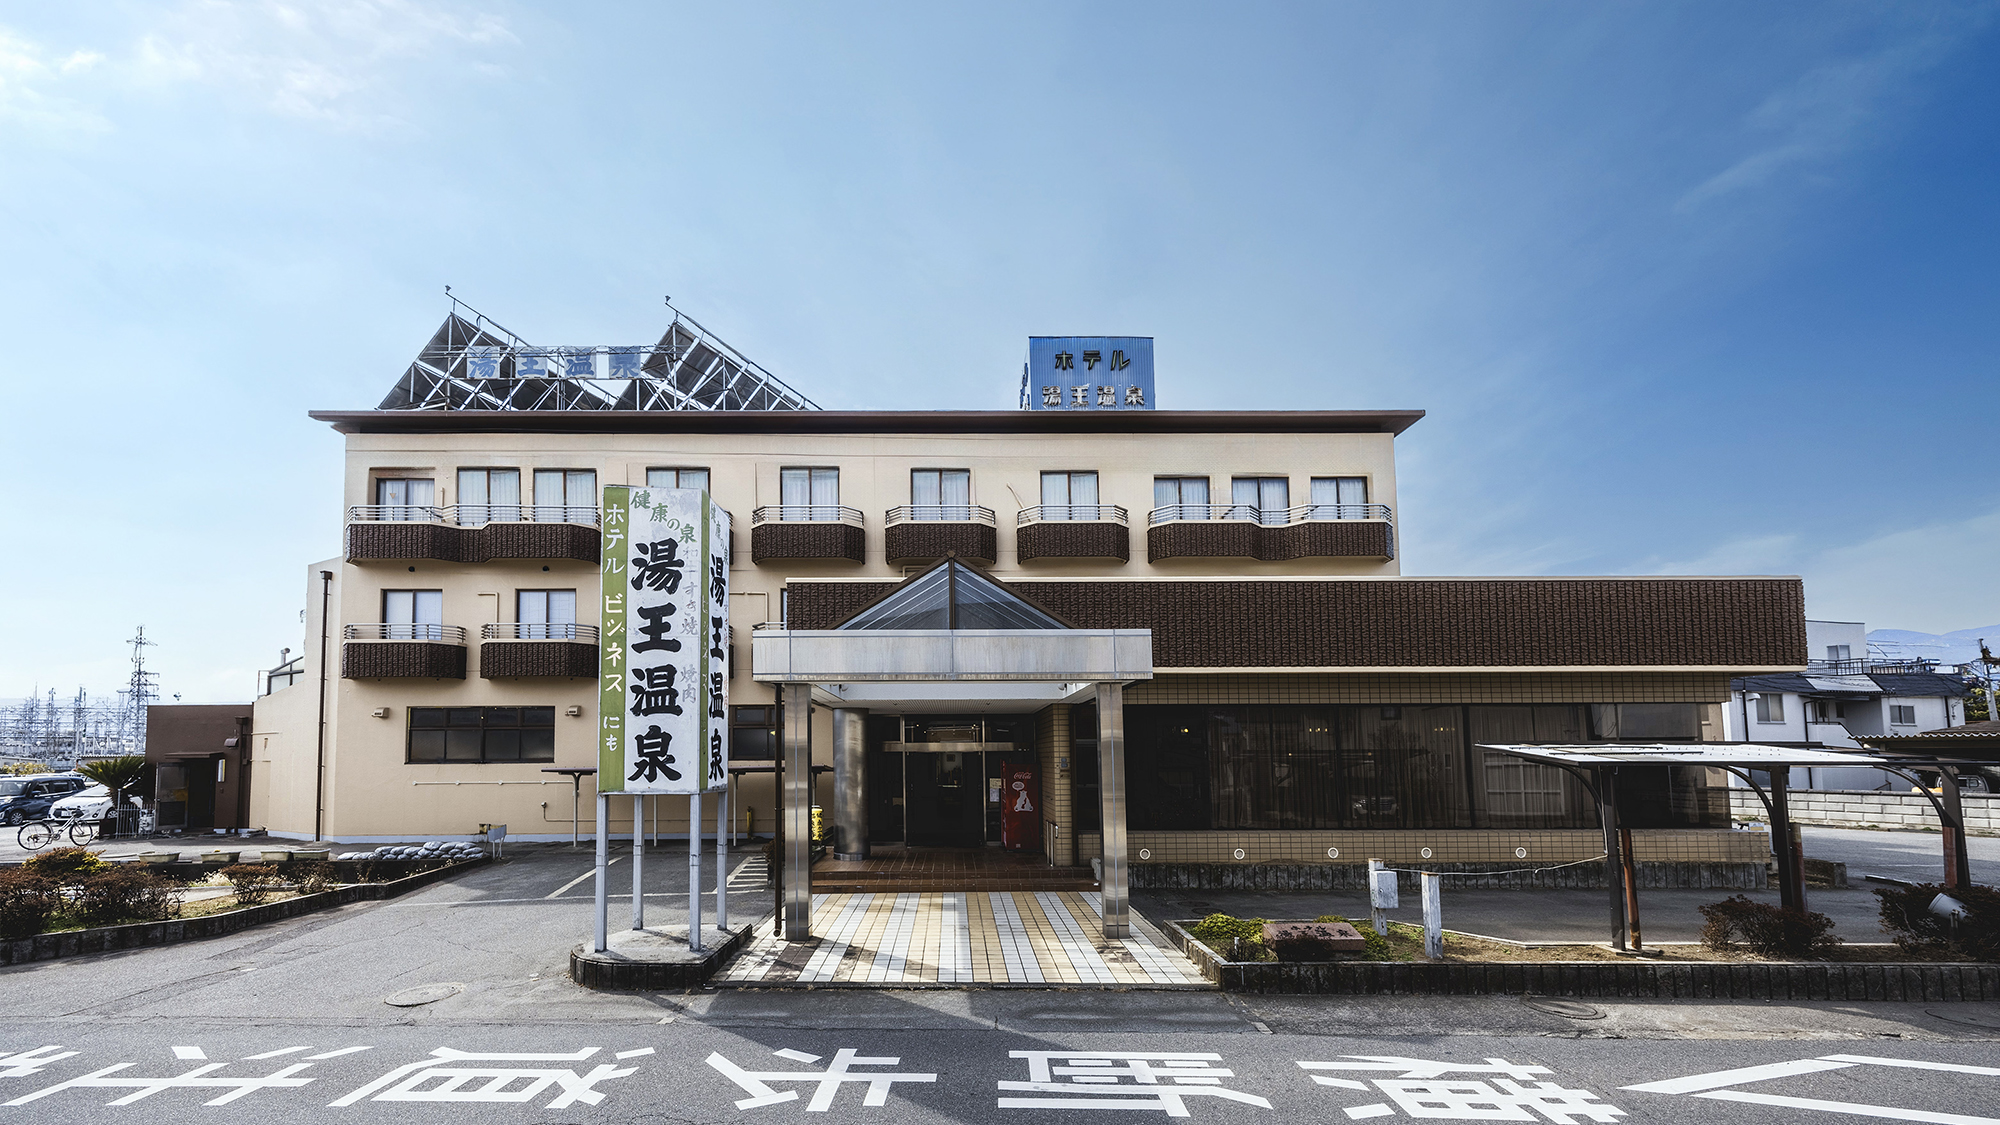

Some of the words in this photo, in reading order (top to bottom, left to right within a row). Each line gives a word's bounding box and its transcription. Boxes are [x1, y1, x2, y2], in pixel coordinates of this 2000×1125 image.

[468, 346, 638, 378] 湯王温泉
[1055, 350, 1130, 371] ホテル
[1042, 384, 1145, 407] 湯王温泉
[604, 503, 625, 574] ホテル
[630, 489, 697, 544] 健康の泉
[604, 592, 625, 692] ビジネス
[627, 537, 685, 783] 湯王温泉
[680, 664, 698, 704] 焼肉
[709, 553, 727, 782] 湯王温泉
[603, 716, 620, 751] にも
